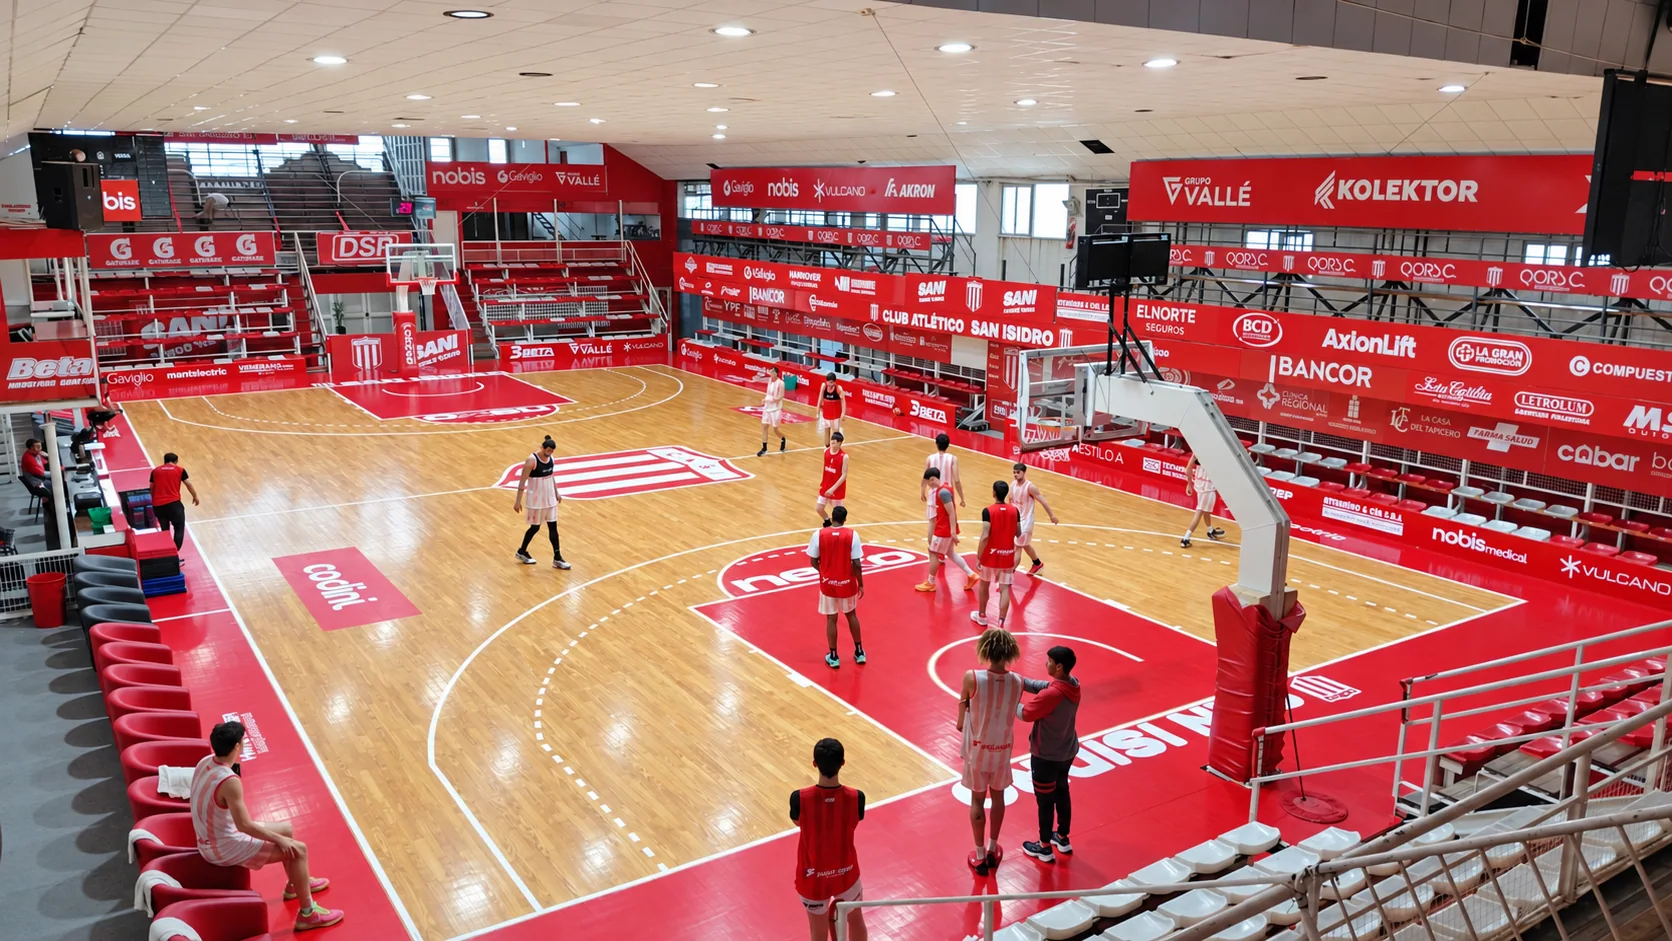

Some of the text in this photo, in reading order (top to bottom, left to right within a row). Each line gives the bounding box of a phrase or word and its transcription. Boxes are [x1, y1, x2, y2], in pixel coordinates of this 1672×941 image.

[433, 167, 486, 185] nobis
[568, 174, 600, 186] VALLÉ
[1184, 177, 1211, 185] GRUPO
[768, 177, 799, 197] nobis
[825, 186, 866, 197] VULCANO
[899, 184, 936, 199] AKRON
[1184, 180, 1252, 206] VALLÉ
[1338, 178, 1479, 203] KOLEKTOR
[752, 287, 785, 304] BANCOR
[724, 300, 741, 312] YPF
[882, 309, 1054, 346] CLUB ATLÉTICO SAN ISIDRO
[1145, 322, 1185, 336] SEGUROS
[1243, 318, 1273, 334] BCD
[1321, 328, 1417, 358] AxionLift
[1475, 346, 1523, 361] LA GRAN
[6, 356, 95, 381] Beta
[1278, 355, 1373, 389] BANCOR
[106, 372, 155, 387] Gaviglio
[1281, 398, 1328, 413] REGIONAL
[1521, 395, 1587, 414] LETROLUM
[1421, 414, 1452, 426] LA CASA
[1410, 423, 1461, 439] DEL TAPICERO
[1504, 433, 1535, 446] SALUD
[730, 550, 916, 593] neo
[303, 563, 378, 611] codini
[1582, 564, 1672, 596] VULCANO
